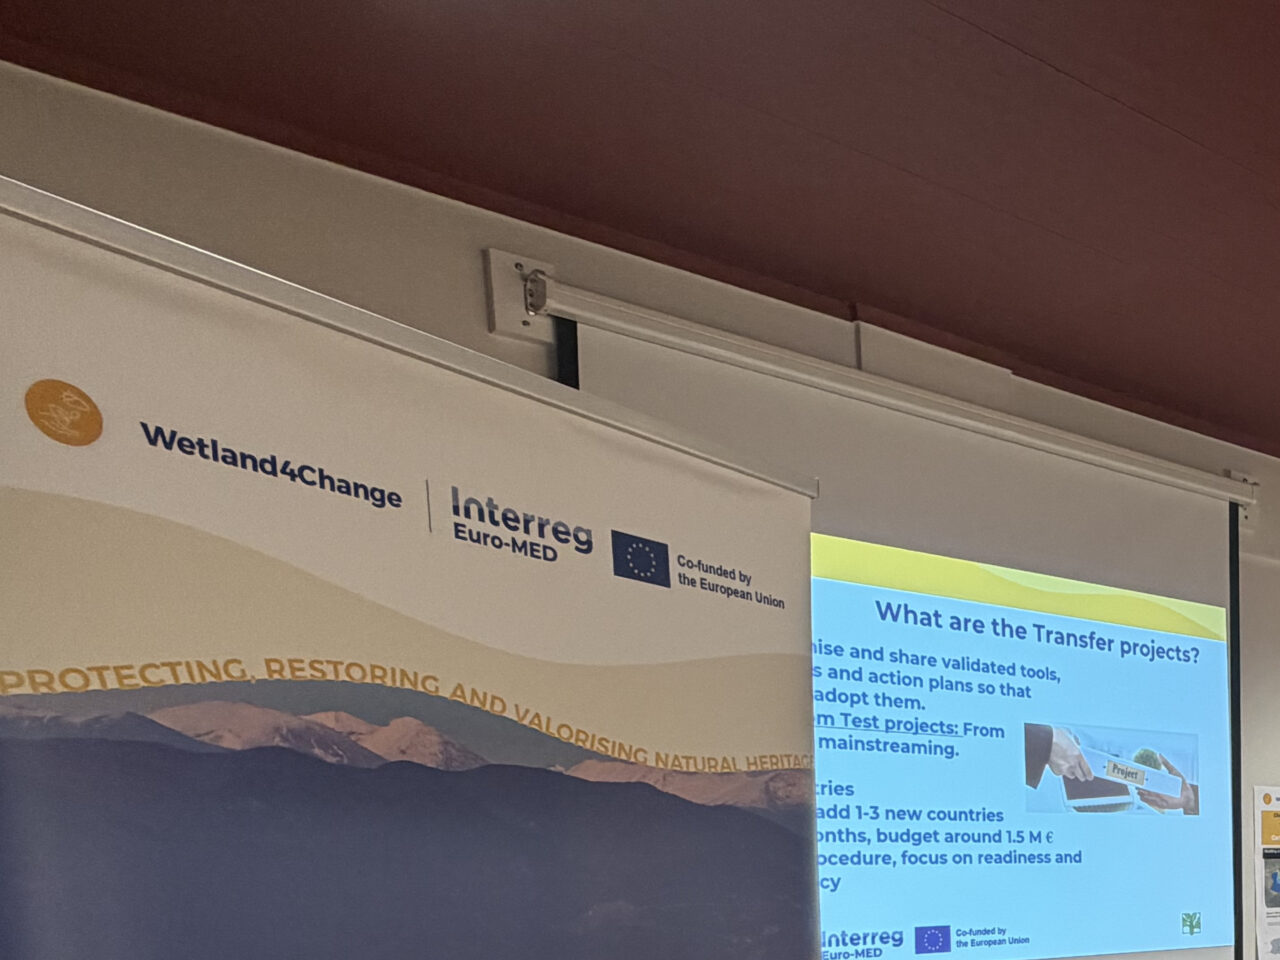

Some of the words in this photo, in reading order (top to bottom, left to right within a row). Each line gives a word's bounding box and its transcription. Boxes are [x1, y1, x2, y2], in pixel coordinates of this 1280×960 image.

[139, 421, 403, 509] Wetland4Change
[451, 486, 593, 555] Interreg
[453, 521, 558, 562] Euro-MED
[677, 554, 736, 581] Co-funded
[738, 570, 752, 587] by
[678, 572, 697, 588] the
[700, 577, 753, 601] European
[755, 591, 785, 610] Union
[875, 600, 943, 629] What
[949, 615, 985, 634] are
[991, 617, 1027, 640] the
[1032, 622, 1115, 651] Transfer
[1120, 639, 1200, 664] projects?
[849, 646, 884, 662] and
[889, 648, 938, 667] share
[941, 656, 1016, 676] validated
[1020, 664, 1061, 684] tools,
[827, 666, 863, 682] and
[868, 670, 924, 688] action
[929, 675, 974, 693] plans
[977, 683, 996, 695] so
[999, 682, 1032, 699] that
[815, 687, 869, 708] adopt
[873, 692, 926, 710] them.
[0, 657, 256, 695] PROTECTING,
[264, 657, 441, 697] RESTORING
[448, 682, 507, 716] AND
[514, 702, 649, 767] VALORISING
[654, 750, 742, 773] NATURAL
[839, 712, 880, 729] Test
[885, 717, 958, 735] projects:
[963, 722, 1005, 739] From
[818, 734, 960, 758] mainstreaming.
[1111, 763, 1138, 780] Project
[816, 804, 851, 820] add
[855, 805, 880, 820] 1-3
[885, 809, 923, 821] new
[927, 807, 1004, 822] countries
[876, 828, 940, 846] budget
[944, 829, 1002, 843] around
[1005, 830, 1025, 844] 1.5
[1029, 830, 1042, 844] M
[1045, 831, 1054, 844] €
[901, 850, 948, 865] focus
[952, 853, 973, 865] on
[978, 849, 1052, 864] readiness
[1055, 850, 1082, 864] and
[822, 929, 904, 949] Interreg
[955, 927, 995, 937] Co-funded
[997, 927, 1007, 936] by
[956, 939, 968, 948] the
[970, 938, 1006, 947] European
[1008, 936, 1030, 945] Union
[822, 947, 883, 960] Euro-MED
